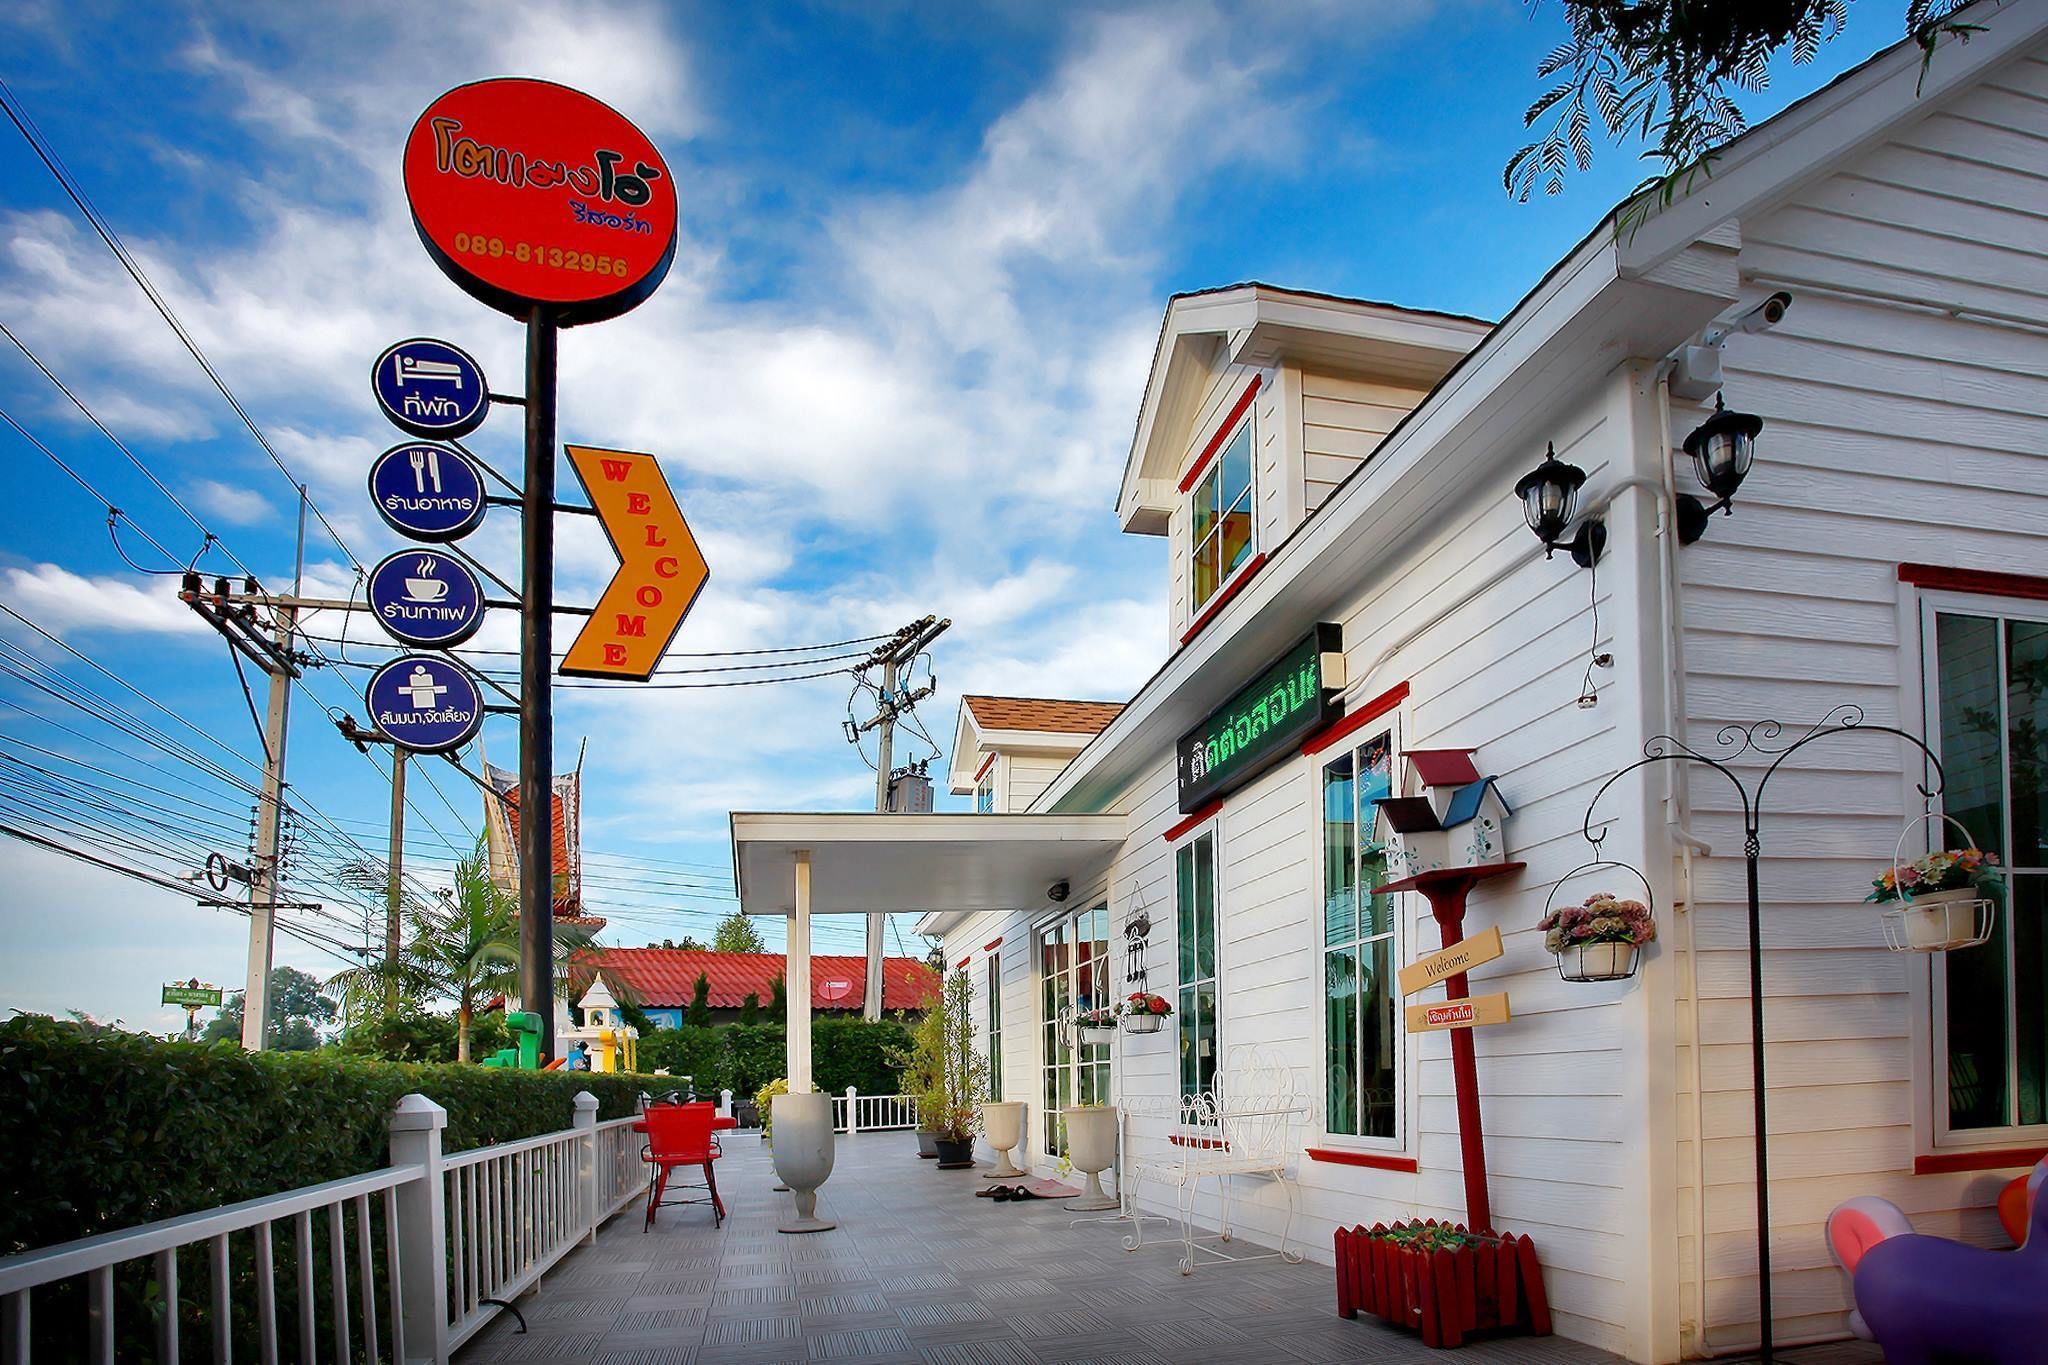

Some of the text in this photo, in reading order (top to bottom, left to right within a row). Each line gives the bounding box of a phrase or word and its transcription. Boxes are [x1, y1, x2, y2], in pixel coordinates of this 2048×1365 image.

[455, 232, 628, 278] 089-8132956
[404, 391, 460, 416] ที่พัก
[385, 494, 473, 511] ร้านอาหาร
[600, 459, 679, 666] WELCOME
[383, 602, 466, 621] ร้านกาแฟ
[1425, 952, 1470, 977] Welcome
